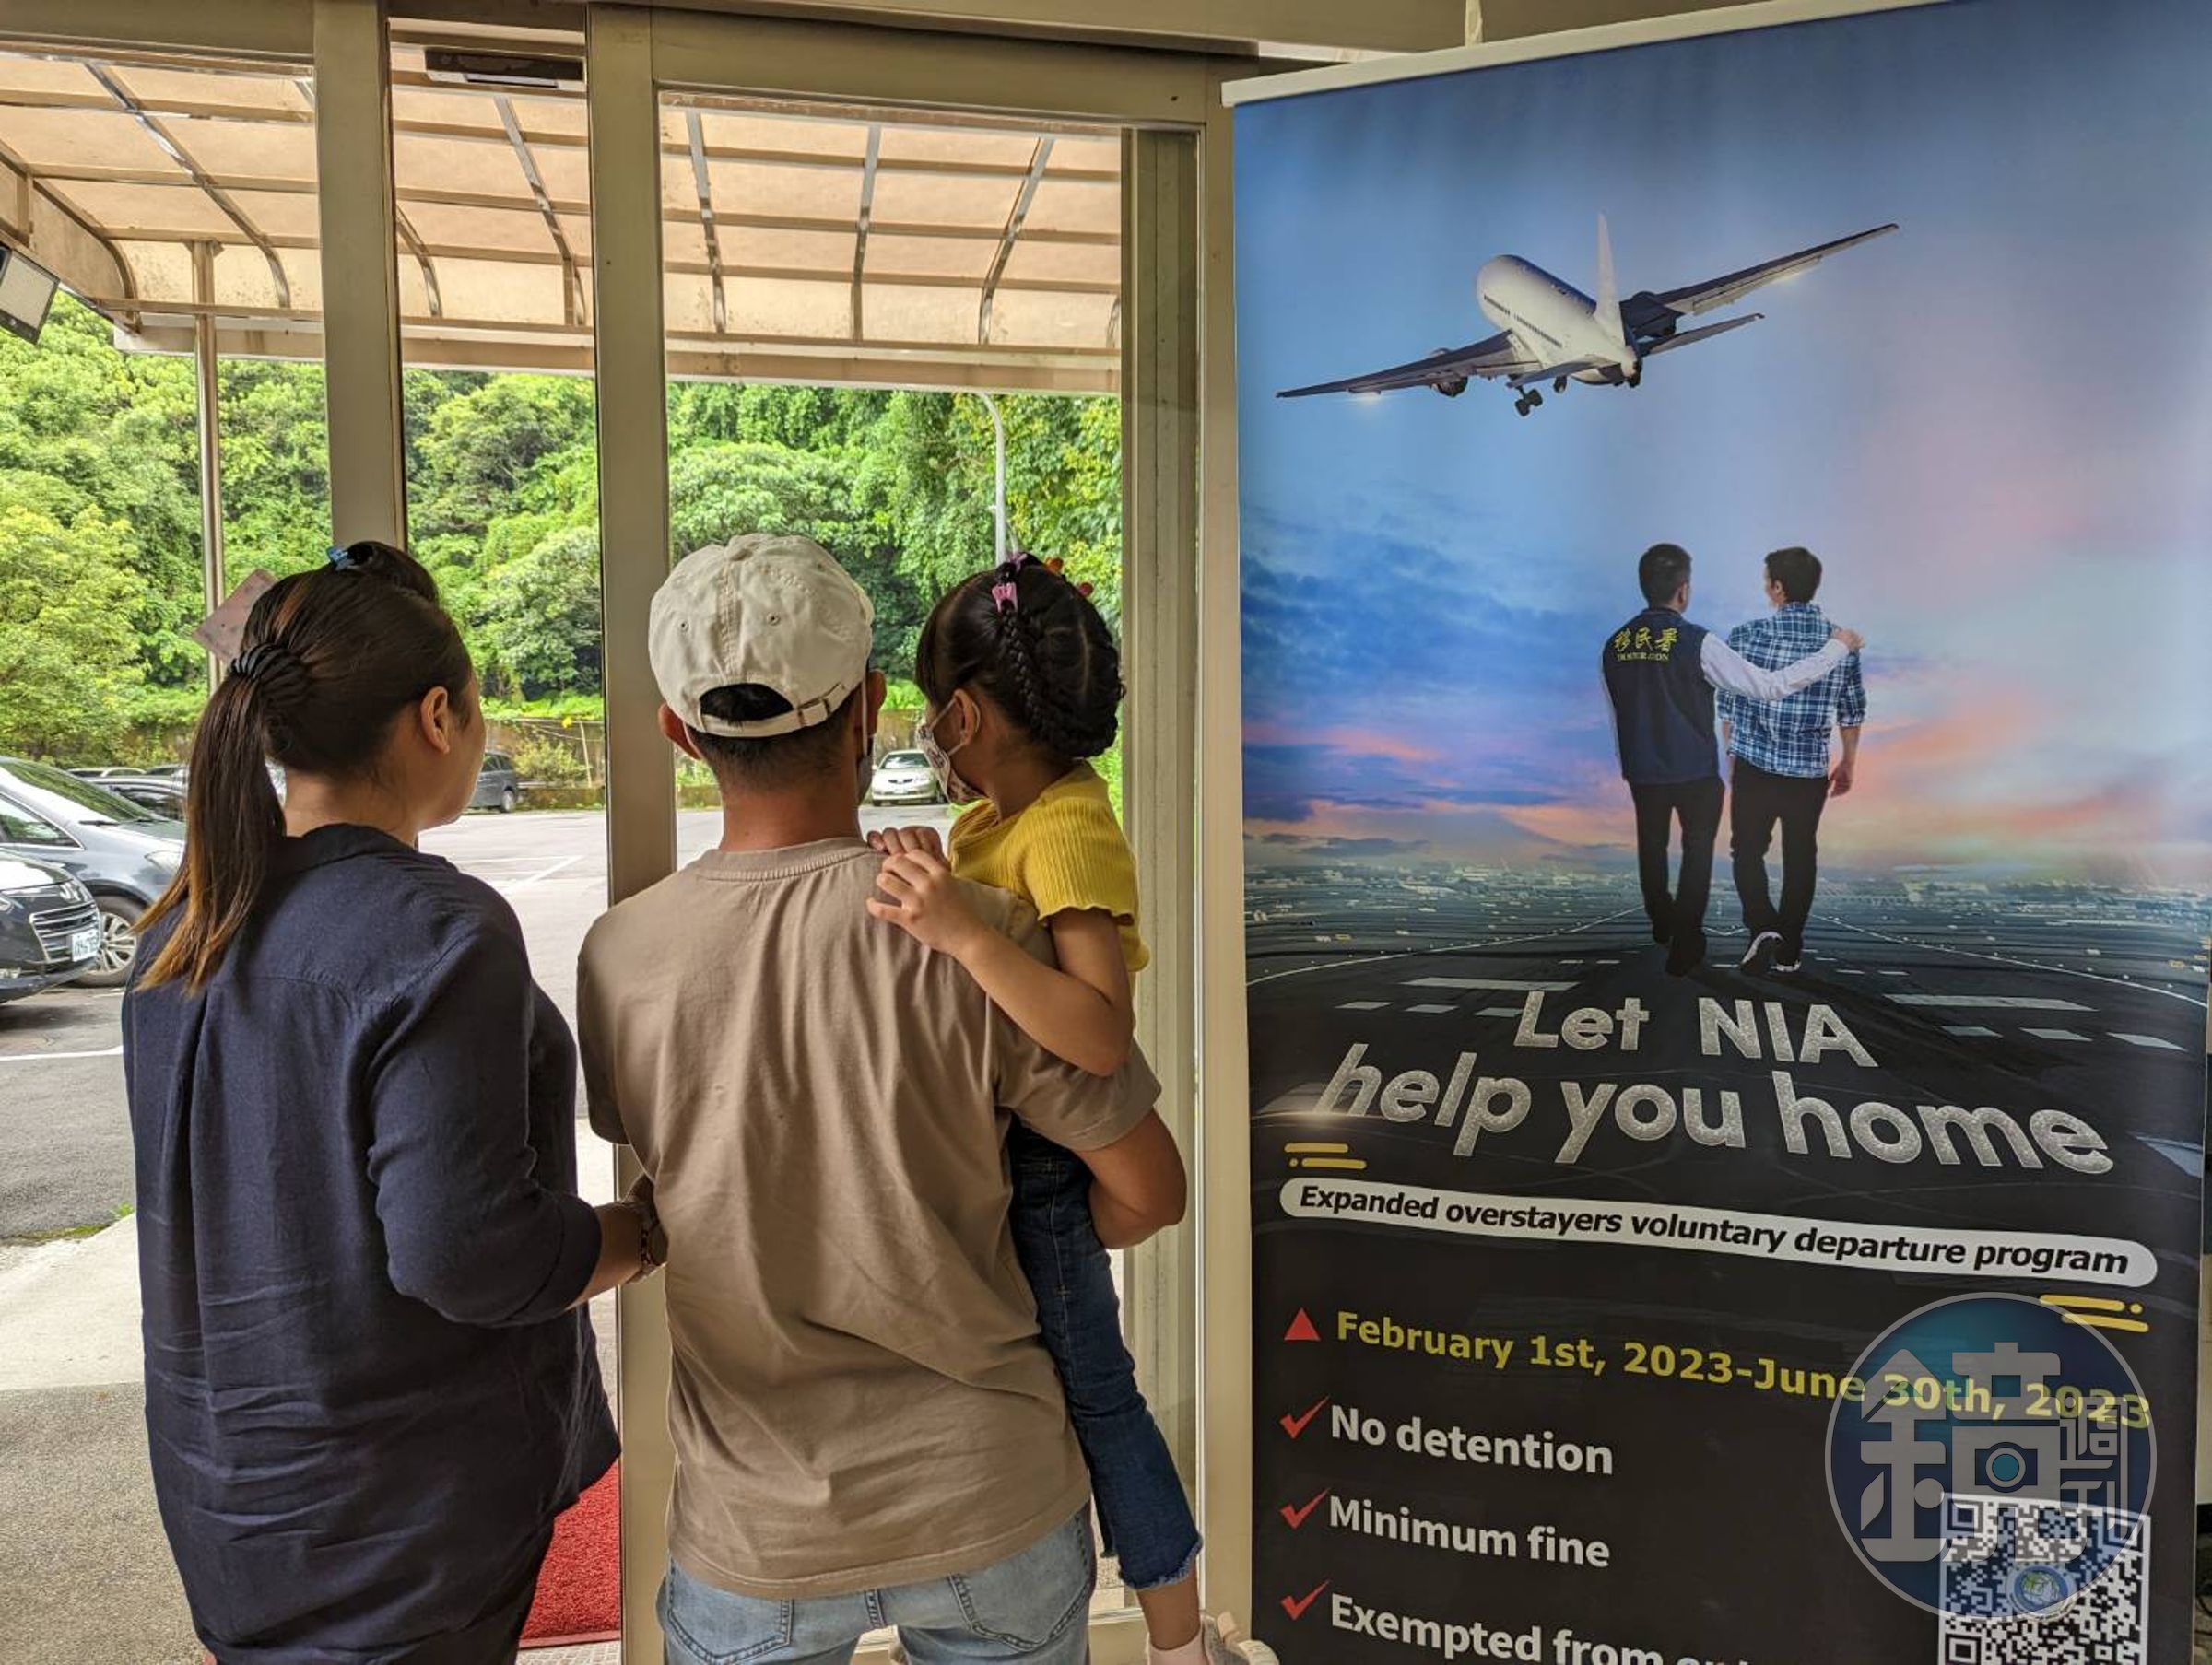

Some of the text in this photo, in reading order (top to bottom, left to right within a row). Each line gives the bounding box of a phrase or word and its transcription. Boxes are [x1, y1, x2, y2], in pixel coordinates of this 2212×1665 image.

[1513, 991, 1878, 1069] Let NIA
[1312, 1042, 2115, 1175] help you home
[1299, 1185, 2130, 1275] Expanded overstayers voluntary departure program
[1336, 1311, 2151, 1428] February 1st, 2023-June 30th, 2023
[1332, 1404, 1614, 1475] No detention
[1330, 1495, 1611, 1568] Minimum fine
[1331, 1593, 1543, 1663] Exempted
